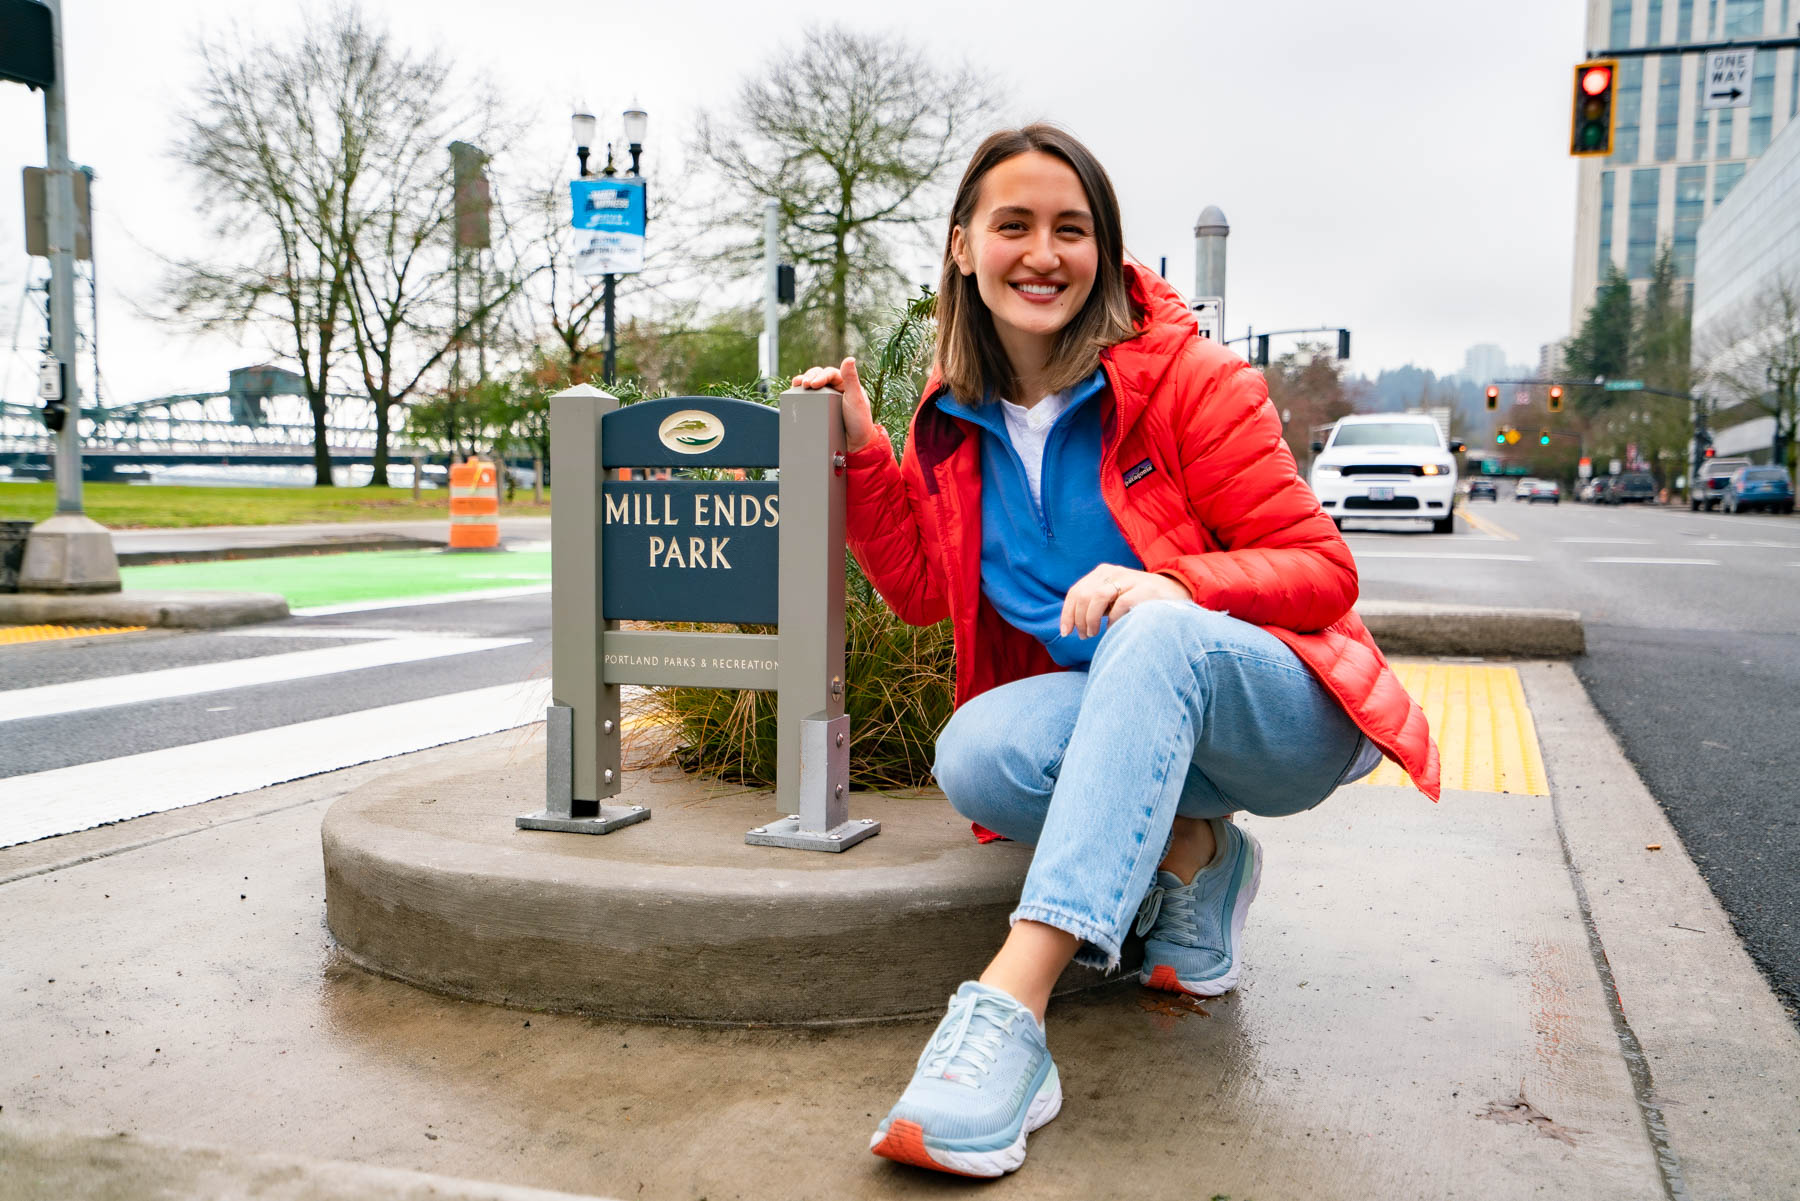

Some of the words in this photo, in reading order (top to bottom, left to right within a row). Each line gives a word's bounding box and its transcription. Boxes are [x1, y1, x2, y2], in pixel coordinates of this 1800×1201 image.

[1714, 55, 1745, 69] ONE
[1711, 70, 1745, 83] WAY
[605, 493, 679, 525] MILL
[694, 494, 779, 527] ENDS
[649, 536, 732, 569] PARK
[604, 654, 659, 666] PORTLAND
[664, 656, 696, 668] PARKS
[701, 658, 707, 668] &
